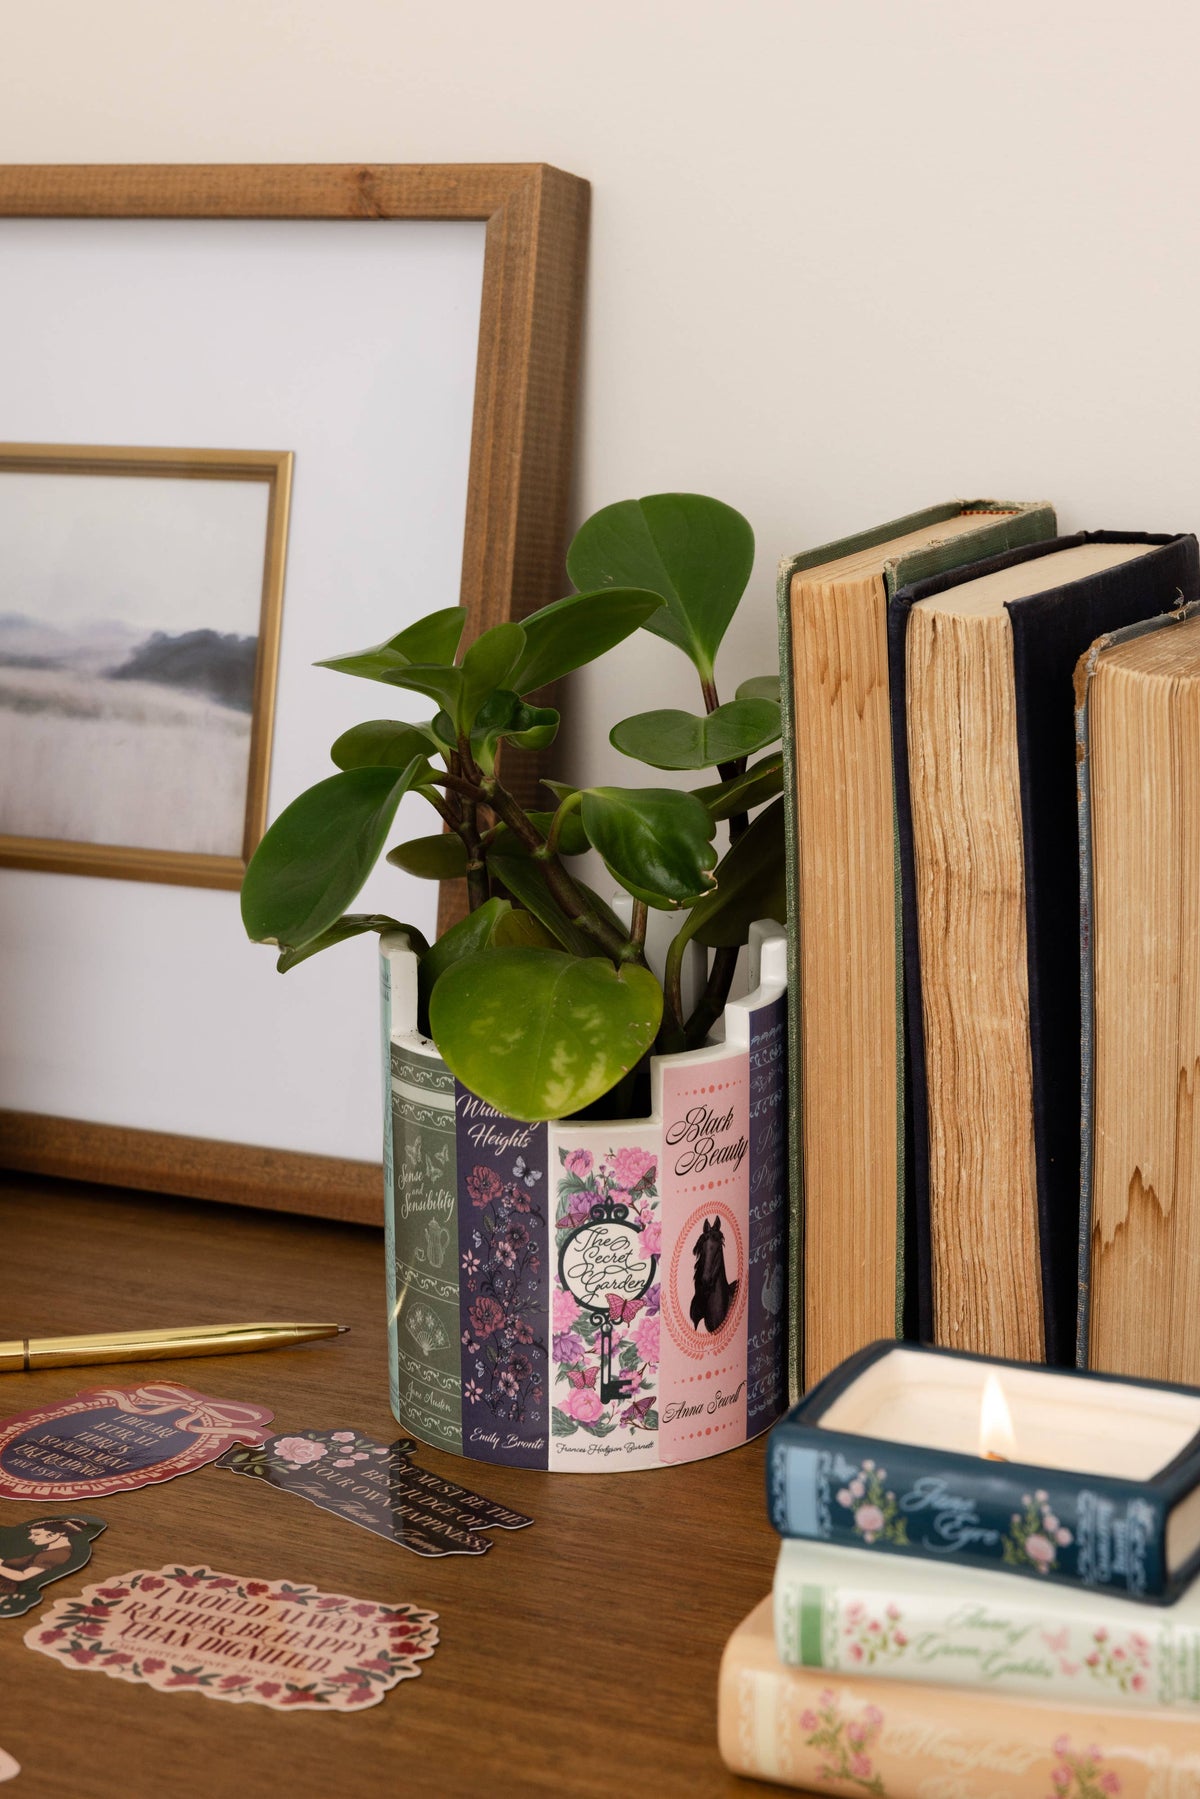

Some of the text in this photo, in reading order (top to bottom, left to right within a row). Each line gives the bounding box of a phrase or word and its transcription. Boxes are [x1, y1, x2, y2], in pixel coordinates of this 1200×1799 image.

[467, 1122, 533, 1156] Heights
[665, 1104, 734, 1146] Black
[674, 1134, 749, 1176] Beauty
[398, 1163, 423, 1190] Sense
[411, 1183, 424, 1196] and
[401, 1189, 455, 1222] Sensibility
[574, 1226, 631, 1252] The
[568, 1245, 647, 1279] Secret
[579, 1265, 646, 1304] Garden
[405, 1380, 452, 1413] Jane Austen
[661, 1379, 747, 1424] Anna Sewell
[469, 1427, 500, 1450] Emily
[555, 1441, 655, 1456] Frances Hodgson Burnett
[307, 1462, 355, 1488] YOUR
[351, 1485, 395, 1507] OWN
[360, 1469, 488, 1527] BEST JUDGE OF
[377, 1453, 528, 1525] YOU MUST BE THE
[120, 1601, 377, 1658] RATHER BE HAPPY
[154, 1587, 389, 1639] I WOULD ALWAYS
[119, 1621, 199, 1648] THAN
